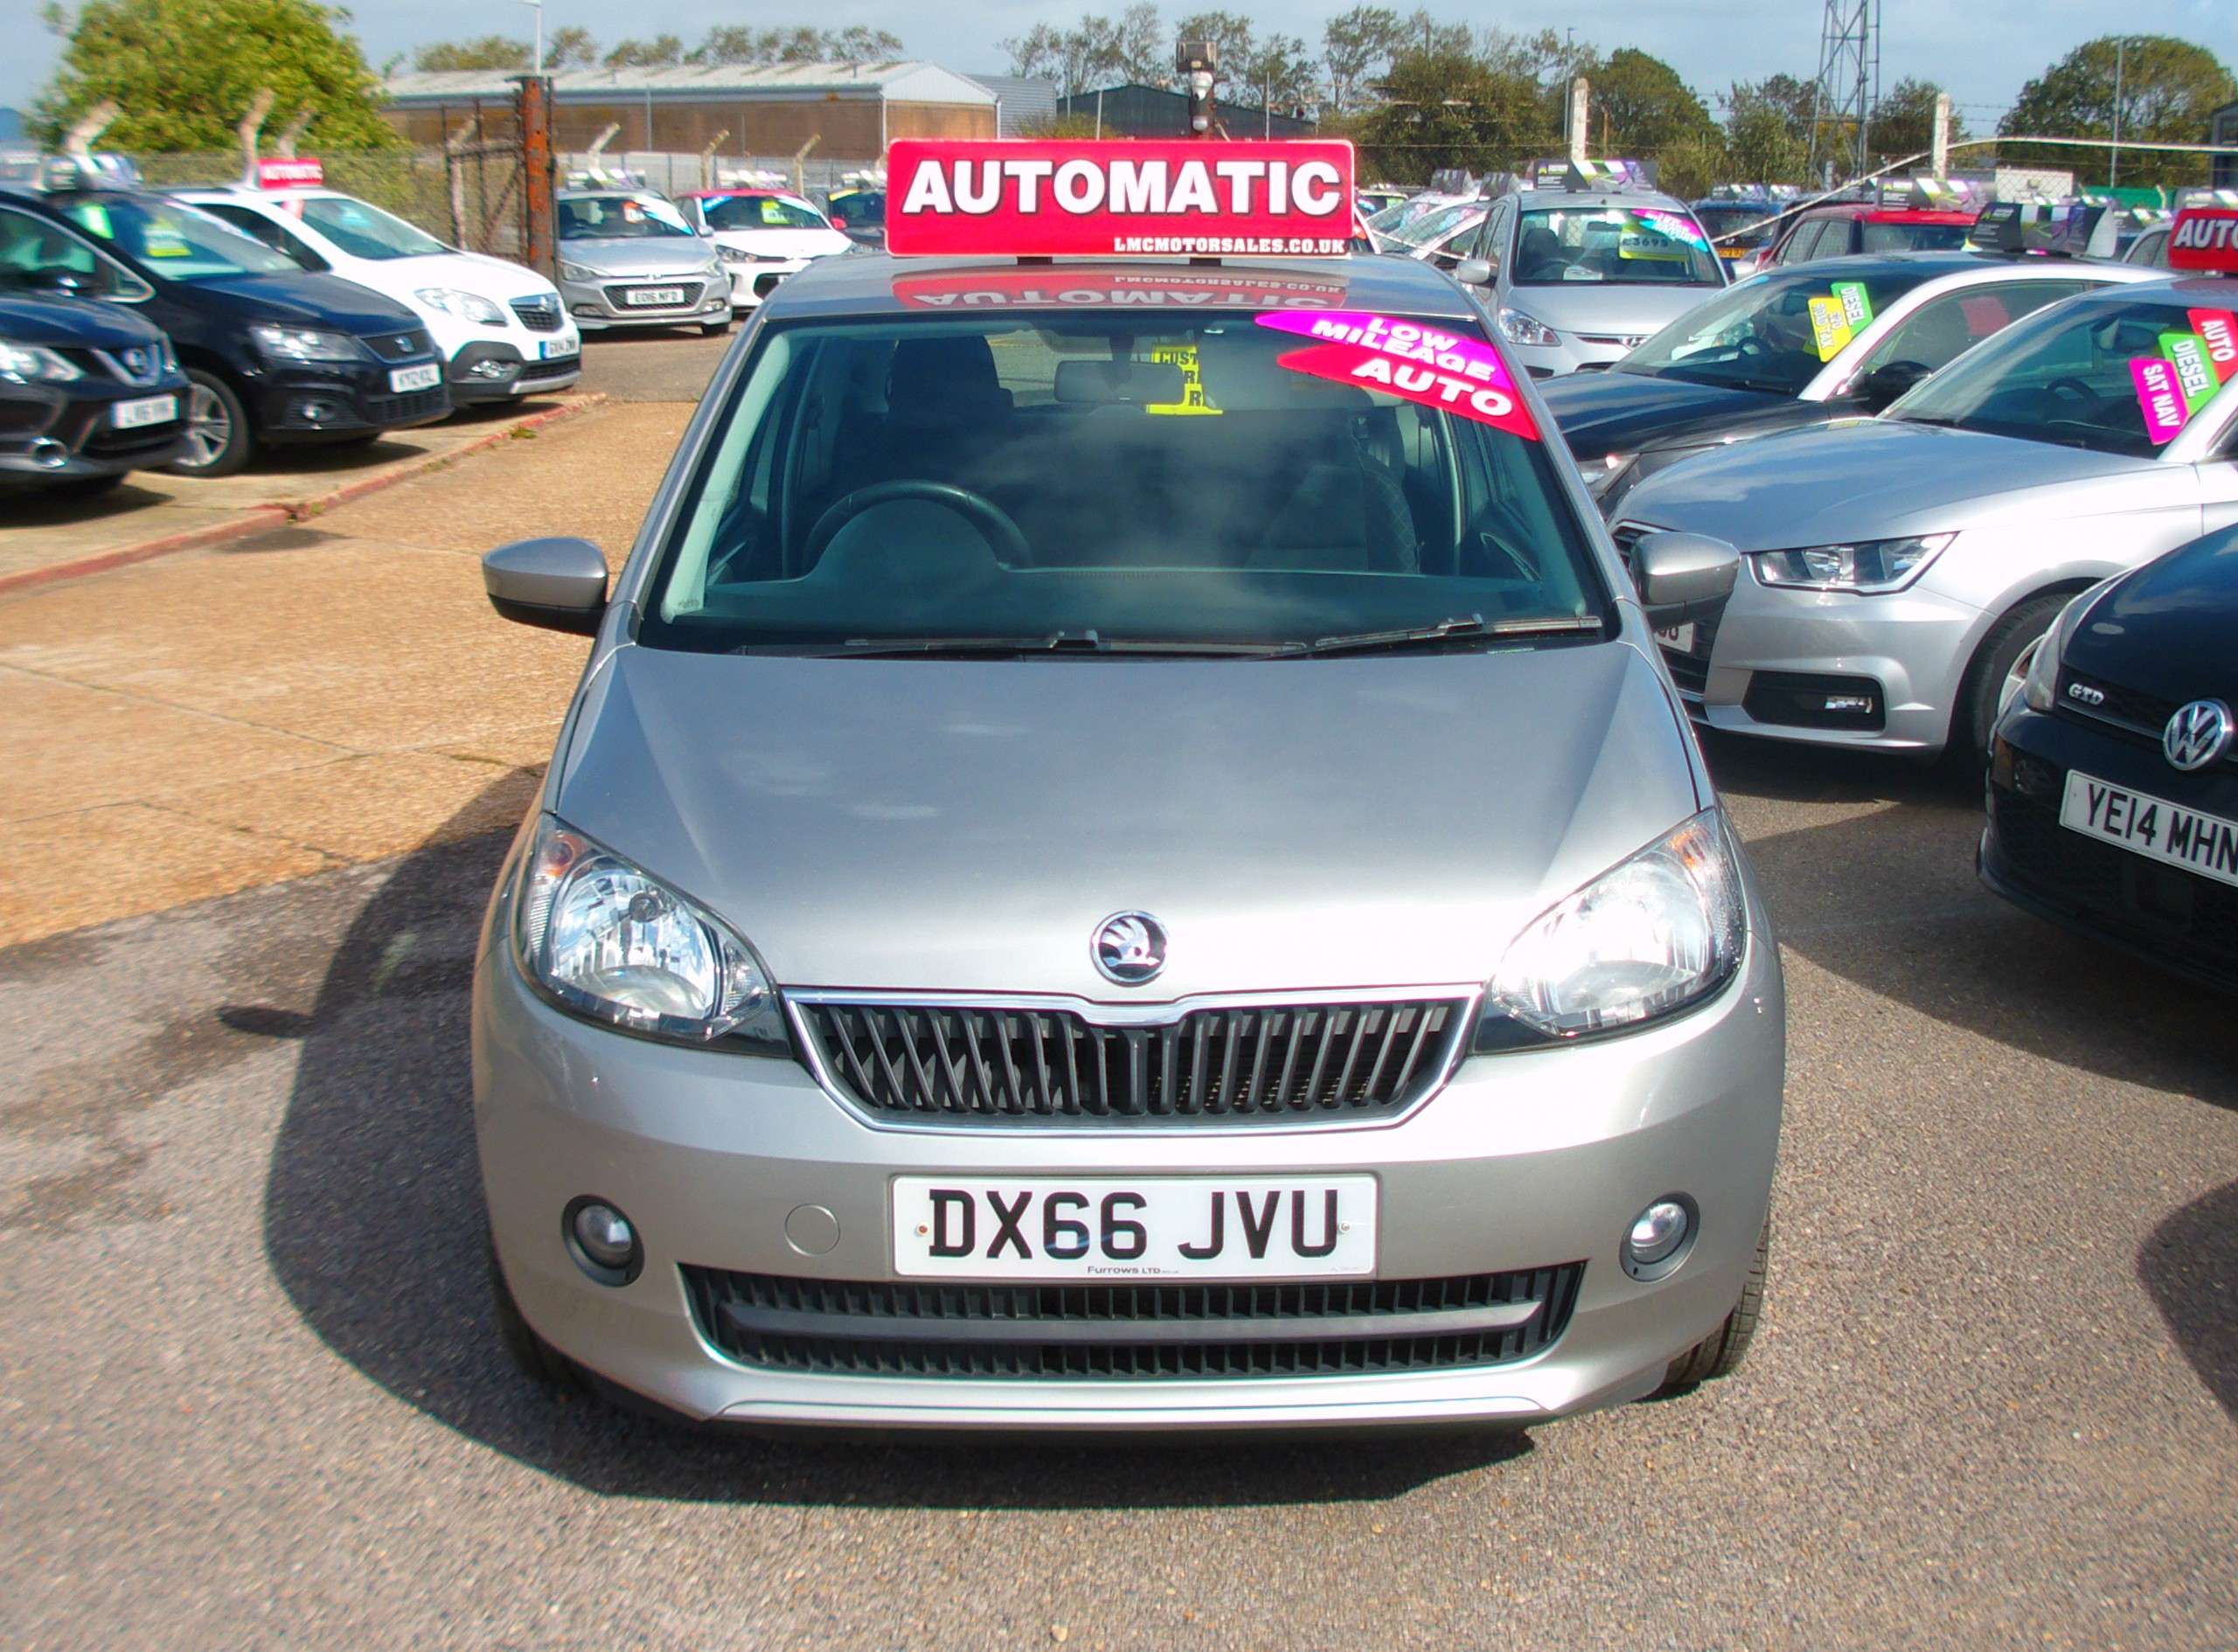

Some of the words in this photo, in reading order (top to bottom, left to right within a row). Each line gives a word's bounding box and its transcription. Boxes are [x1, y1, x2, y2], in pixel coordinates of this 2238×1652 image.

[902, 159, 1342, 216] AUTOMATIC
[1114, 237, 1345, 253] LMCMOTORSALES.CO.UK
[1840, 286, 1865, 325] DIESEL
[1311, 320, 1496, 381] MILEAGE
[1366, 317, 1459, 351] LOW
[1818, 324, 1833, 350] TAX
[2200, 320, 2235, 362] AUTO
[1351, 357, 1512, 416] AUTO
[2143, 364, 2170, 392] SAT
[2172, 338, 2210, 398] DIESEL
[2151, 393, 2181, 427] NAV
[2068, 683, 2104, 705] GTD
[2088, 783, 2158, 847] YE14
[2166, 810, 2238, 875] MHN
[928, 1189, 1148, 1260] DX66
[1177, 1189, 1339, 1260] JVU
[1087, 1266, 1139, 1274] Furrows
